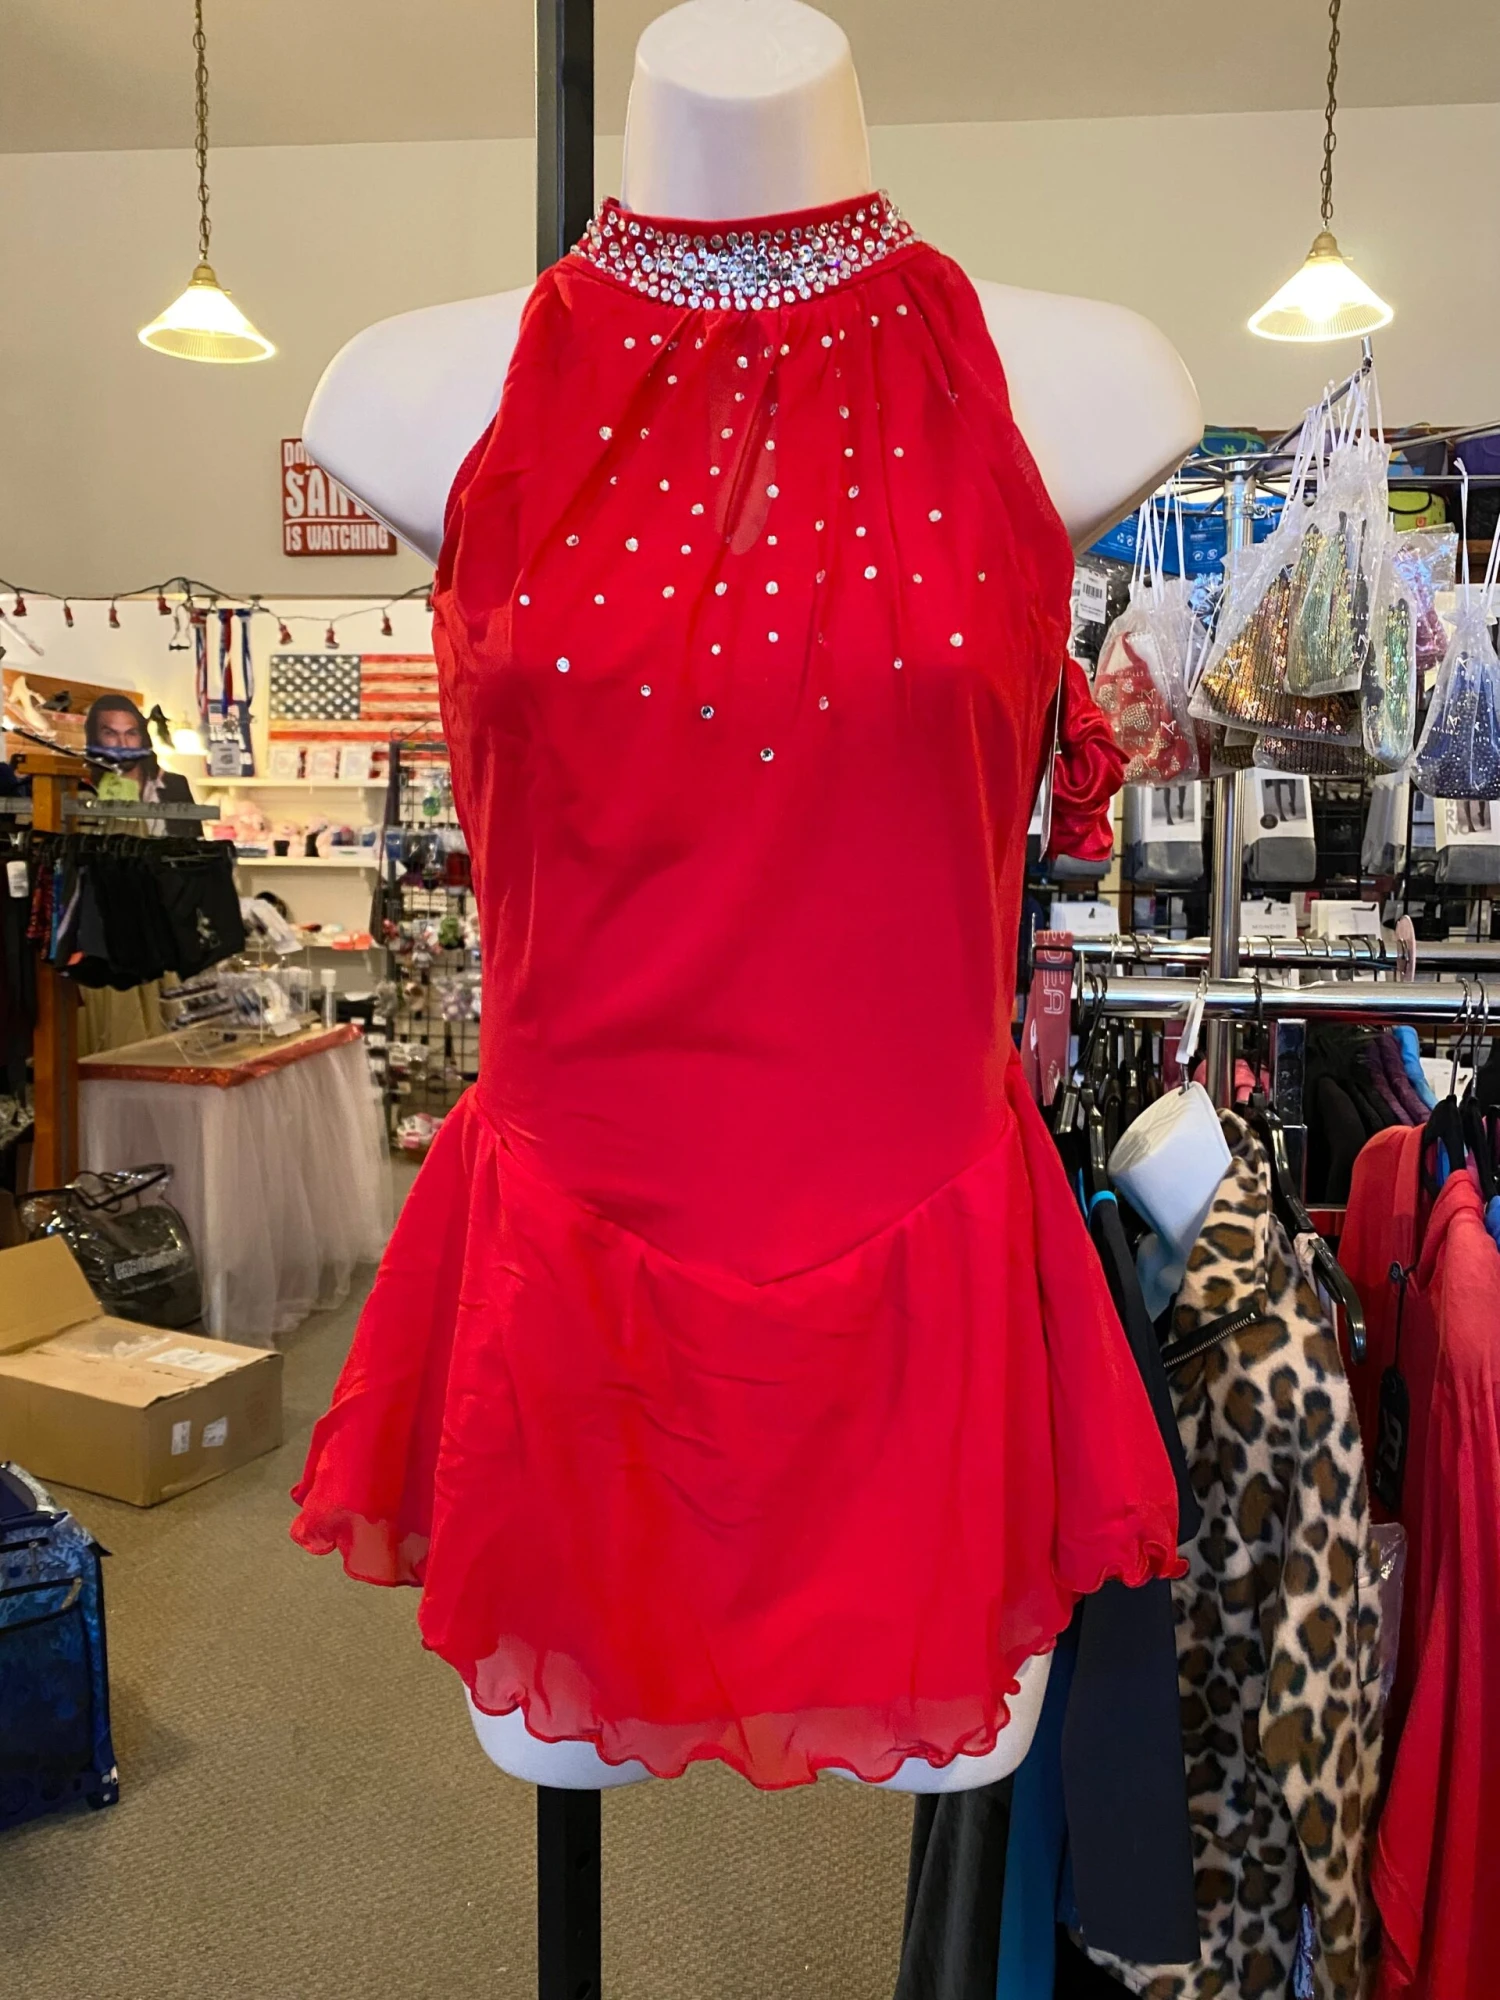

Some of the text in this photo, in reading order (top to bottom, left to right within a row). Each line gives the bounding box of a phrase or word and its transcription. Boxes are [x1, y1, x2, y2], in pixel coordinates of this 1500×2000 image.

[285, 467, 365, 518] SAN
[286, 524, 389, 551] IS WATCHING
